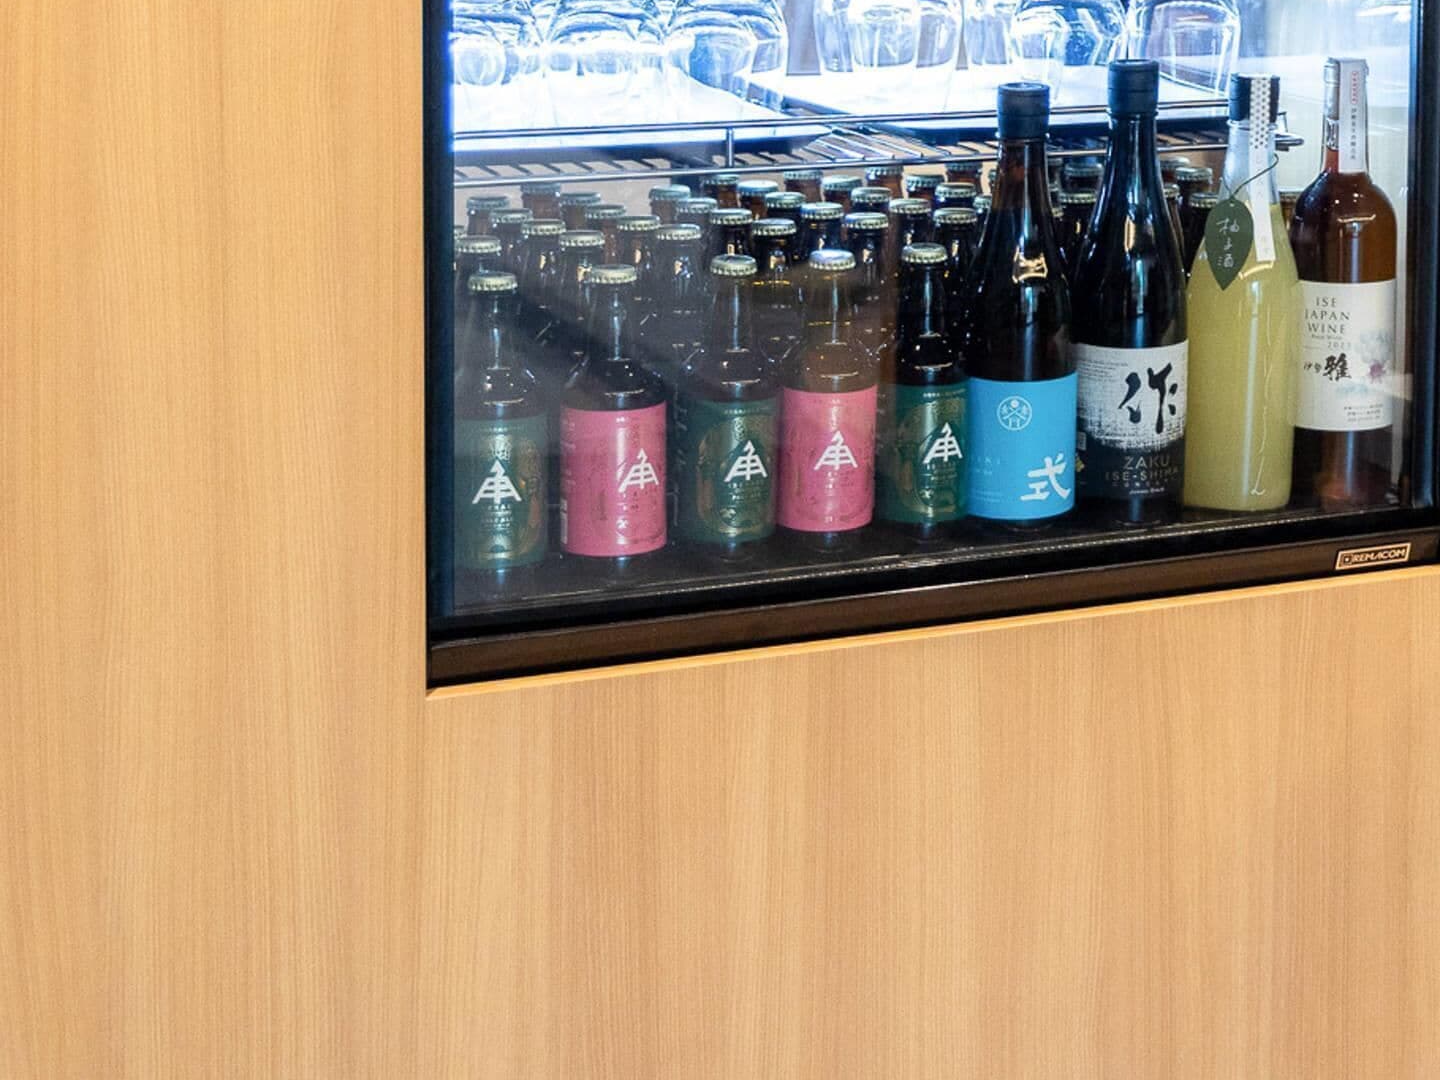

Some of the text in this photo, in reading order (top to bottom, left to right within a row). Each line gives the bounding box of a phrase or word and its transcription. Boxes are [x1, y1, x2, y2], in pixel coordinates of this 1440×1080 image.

[1315, 296, 1337, 308] ISE
[1304, 308, 1350, 321] JAPAN
[1307, 322, 1345, 334] WINE
[1122, 455, 1170, 470] ZAKU
[1020, 452, 1071, 501] 式
